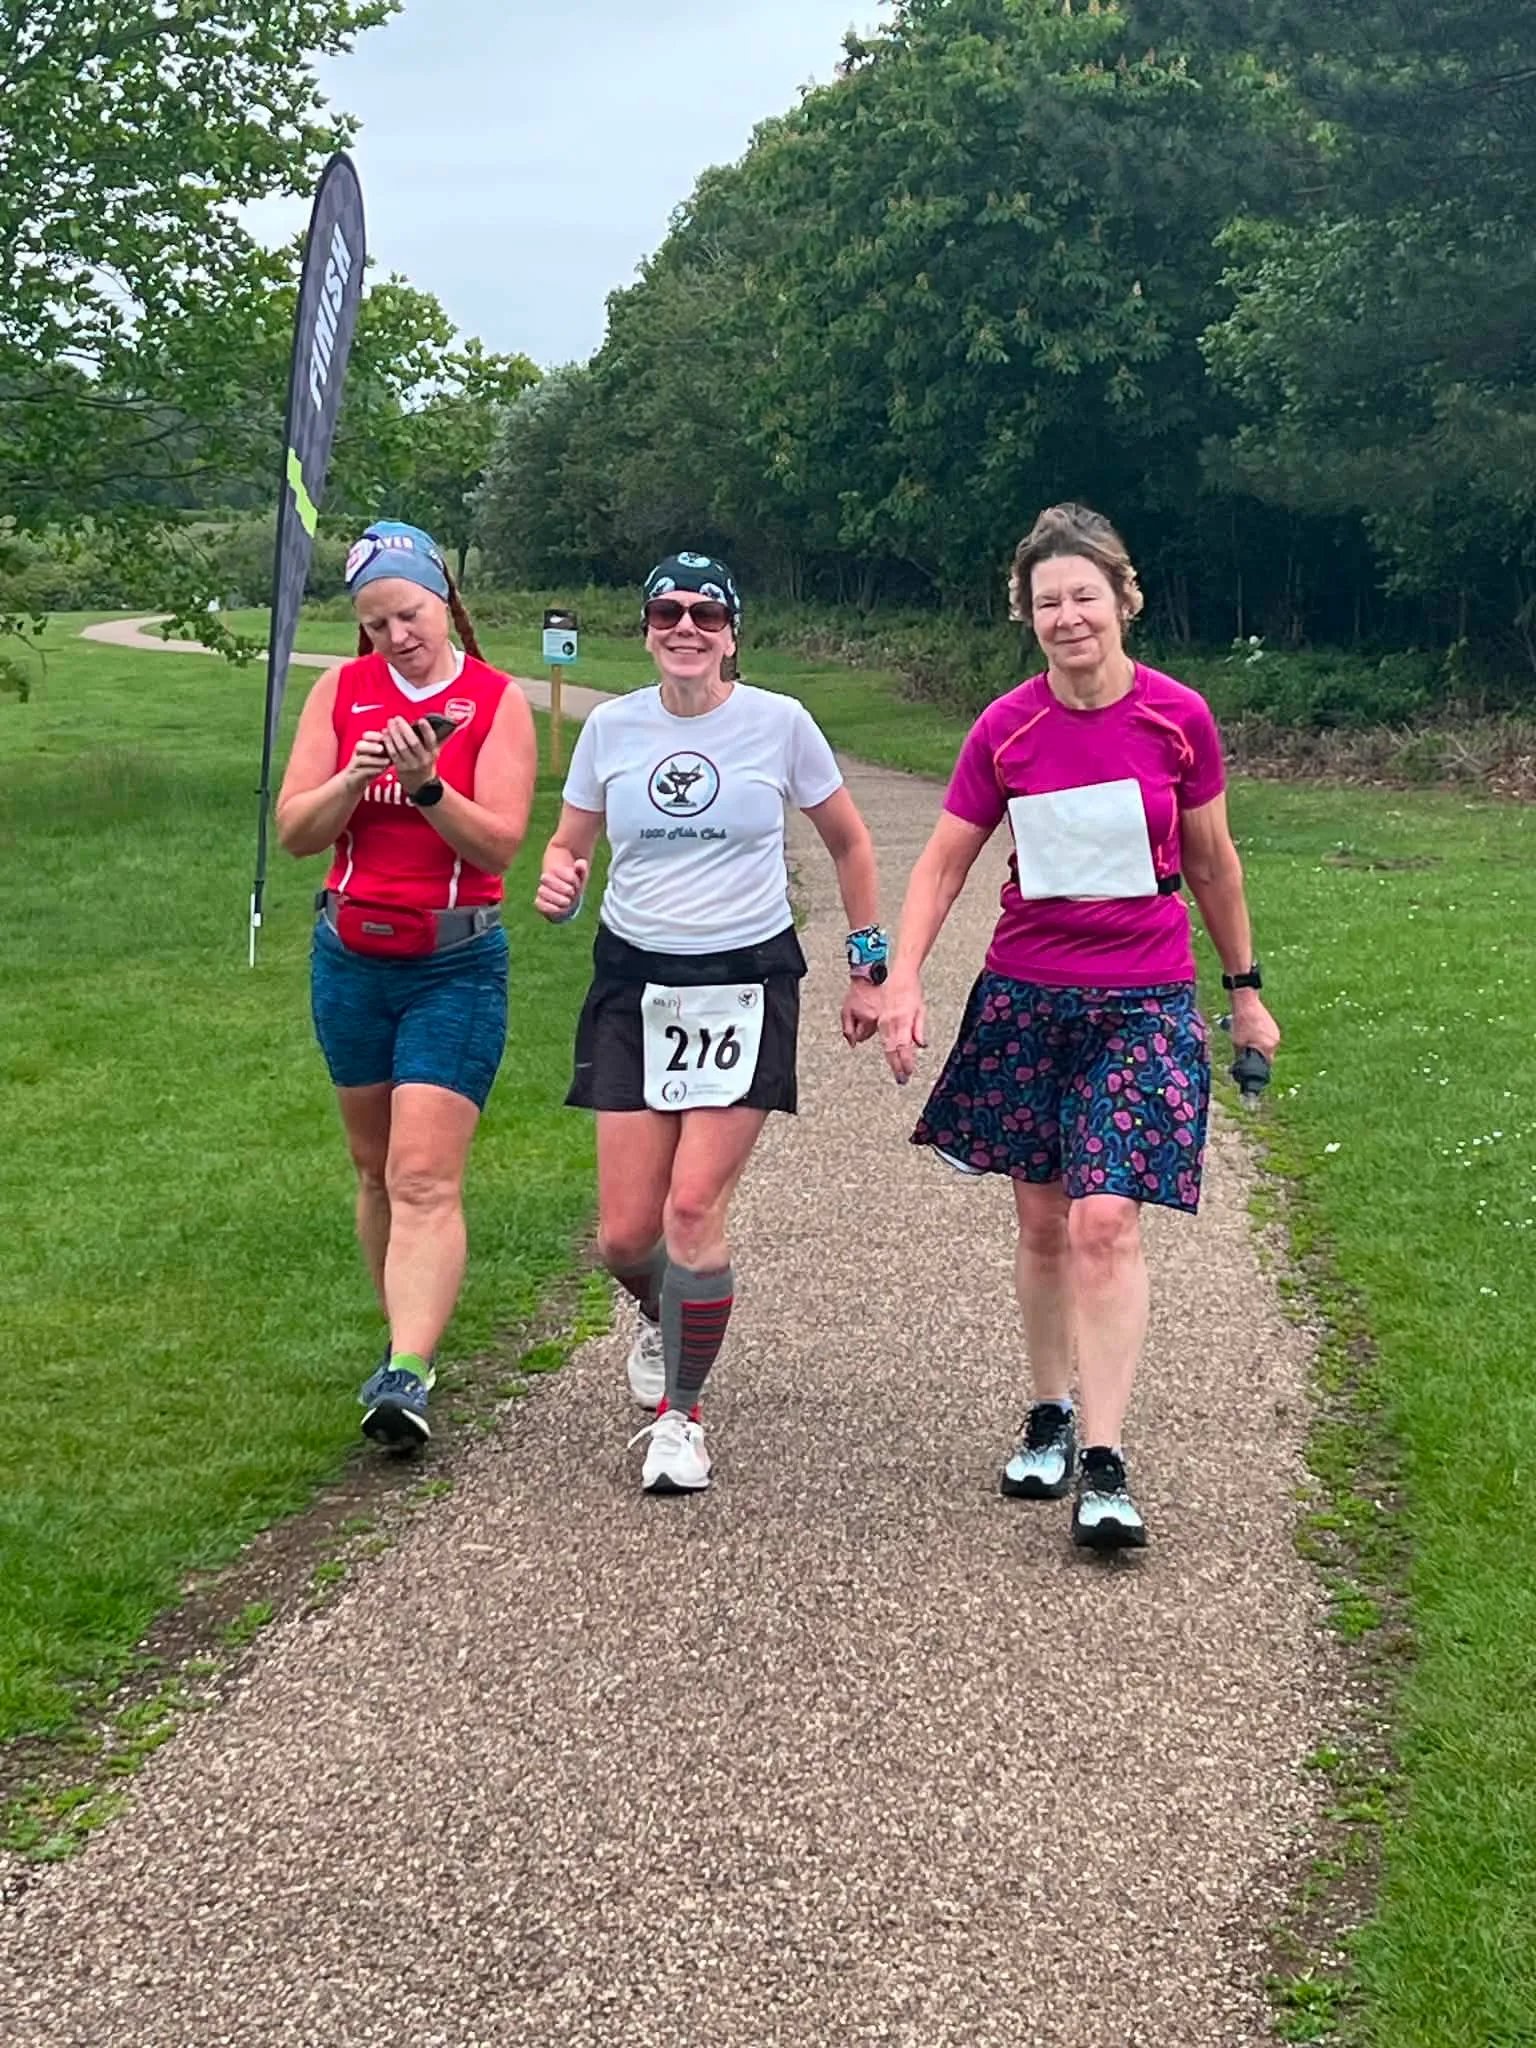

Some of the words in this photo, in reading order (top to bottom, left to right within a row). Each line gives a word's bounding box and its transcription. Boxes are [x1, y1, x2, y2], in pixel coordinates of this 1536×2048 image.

[310, 223, 351, 411] FINISH
[640, 829, 666, 839] 1000
[665, 1024, 741, 1071] 216
